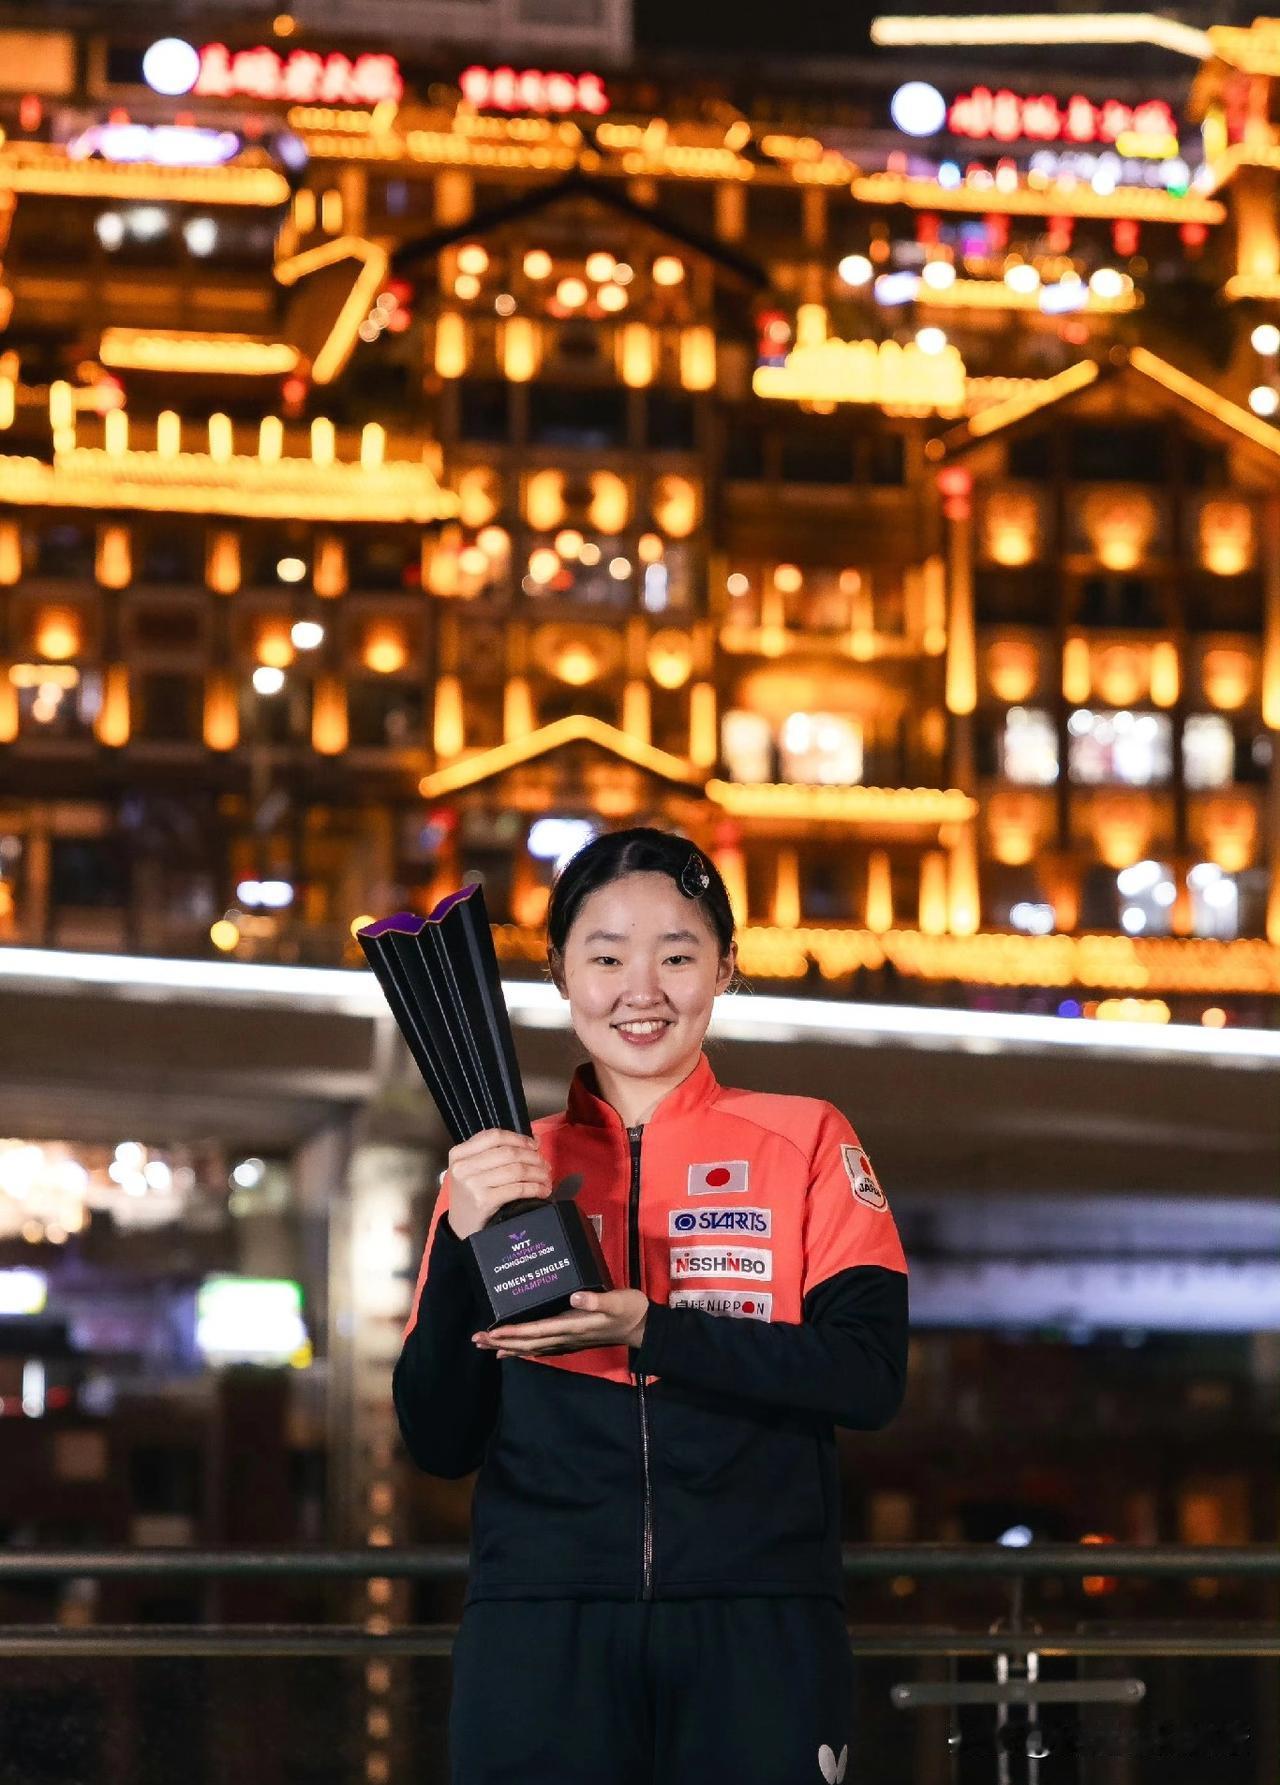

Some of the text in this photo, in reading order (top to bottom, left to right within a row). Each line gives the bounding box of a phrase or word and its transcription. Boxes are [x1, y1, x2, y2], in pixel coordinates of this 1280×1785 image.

[511, 1239, 531, 1252] WTT
[493, 1258, 570, 1294] WOMEN'S SINGLES
[511, 1273, 559, 1296] CHAMPION
